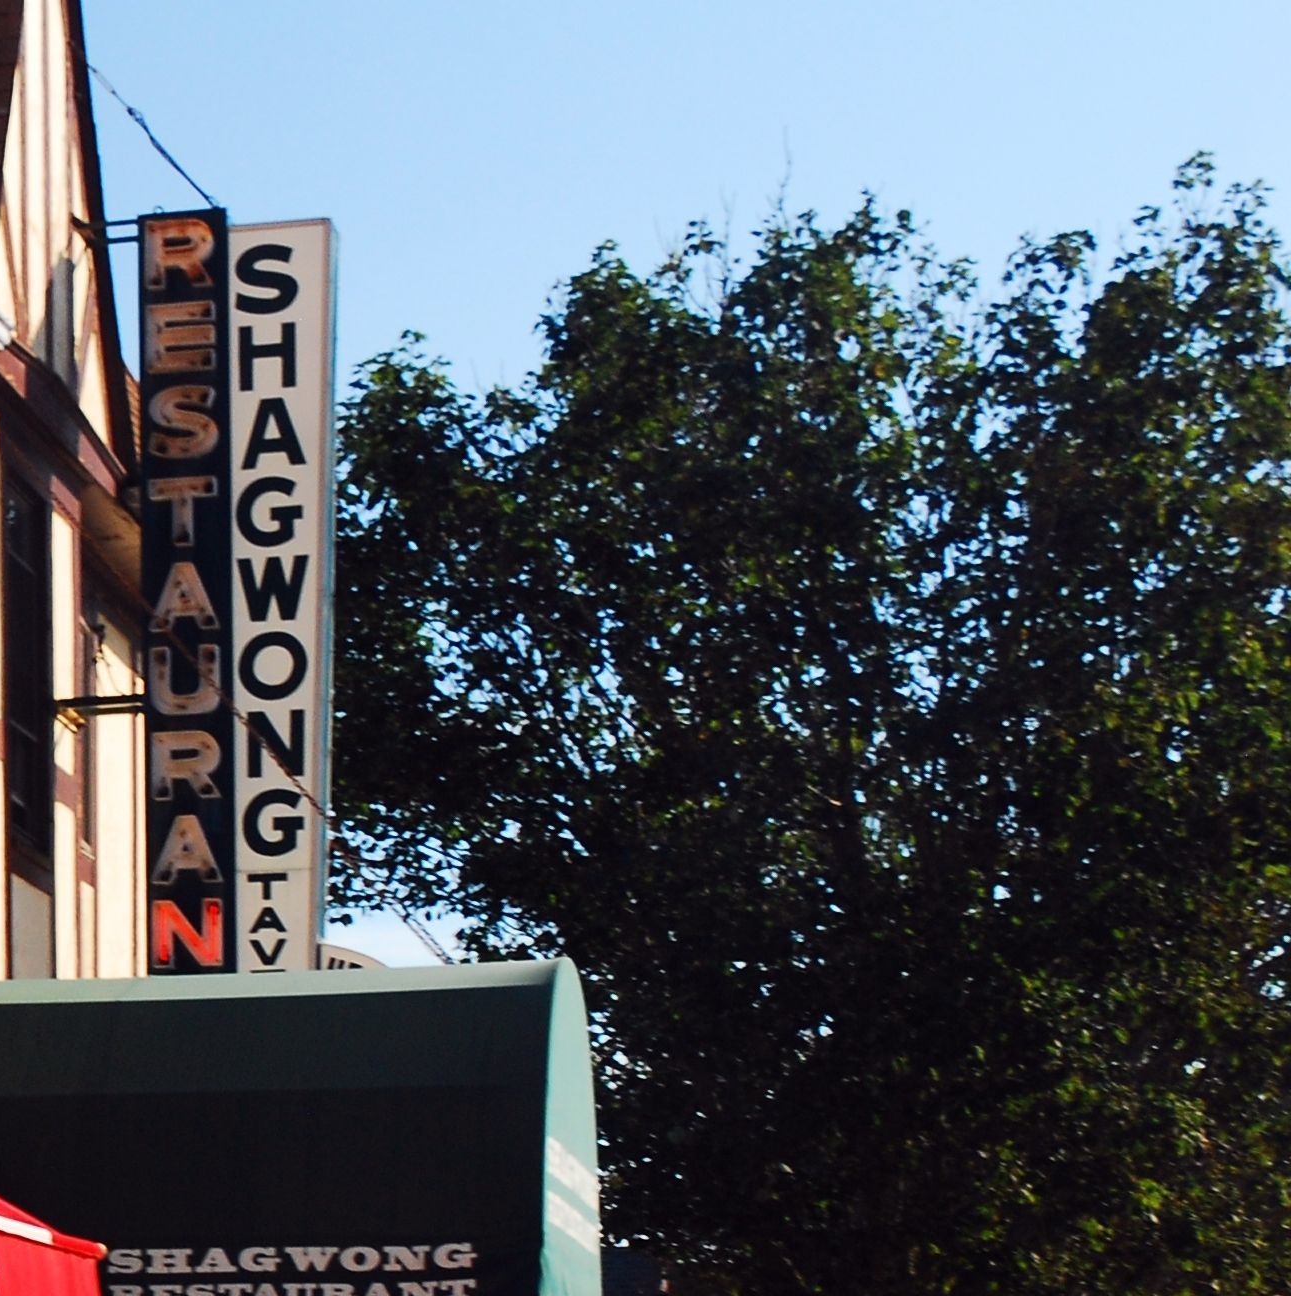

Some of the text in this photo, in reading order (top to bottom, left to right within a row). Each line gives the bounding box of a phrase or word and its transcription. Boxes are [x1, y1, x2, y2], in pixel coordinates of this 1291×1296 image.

[145, 217, 223, 968] RESTAURAN
[235, 243, 308, 858] SHAGWONG
[247, 872, 289, 974] TAV
[106, 1242, 478, 1275] SHAGWONG
